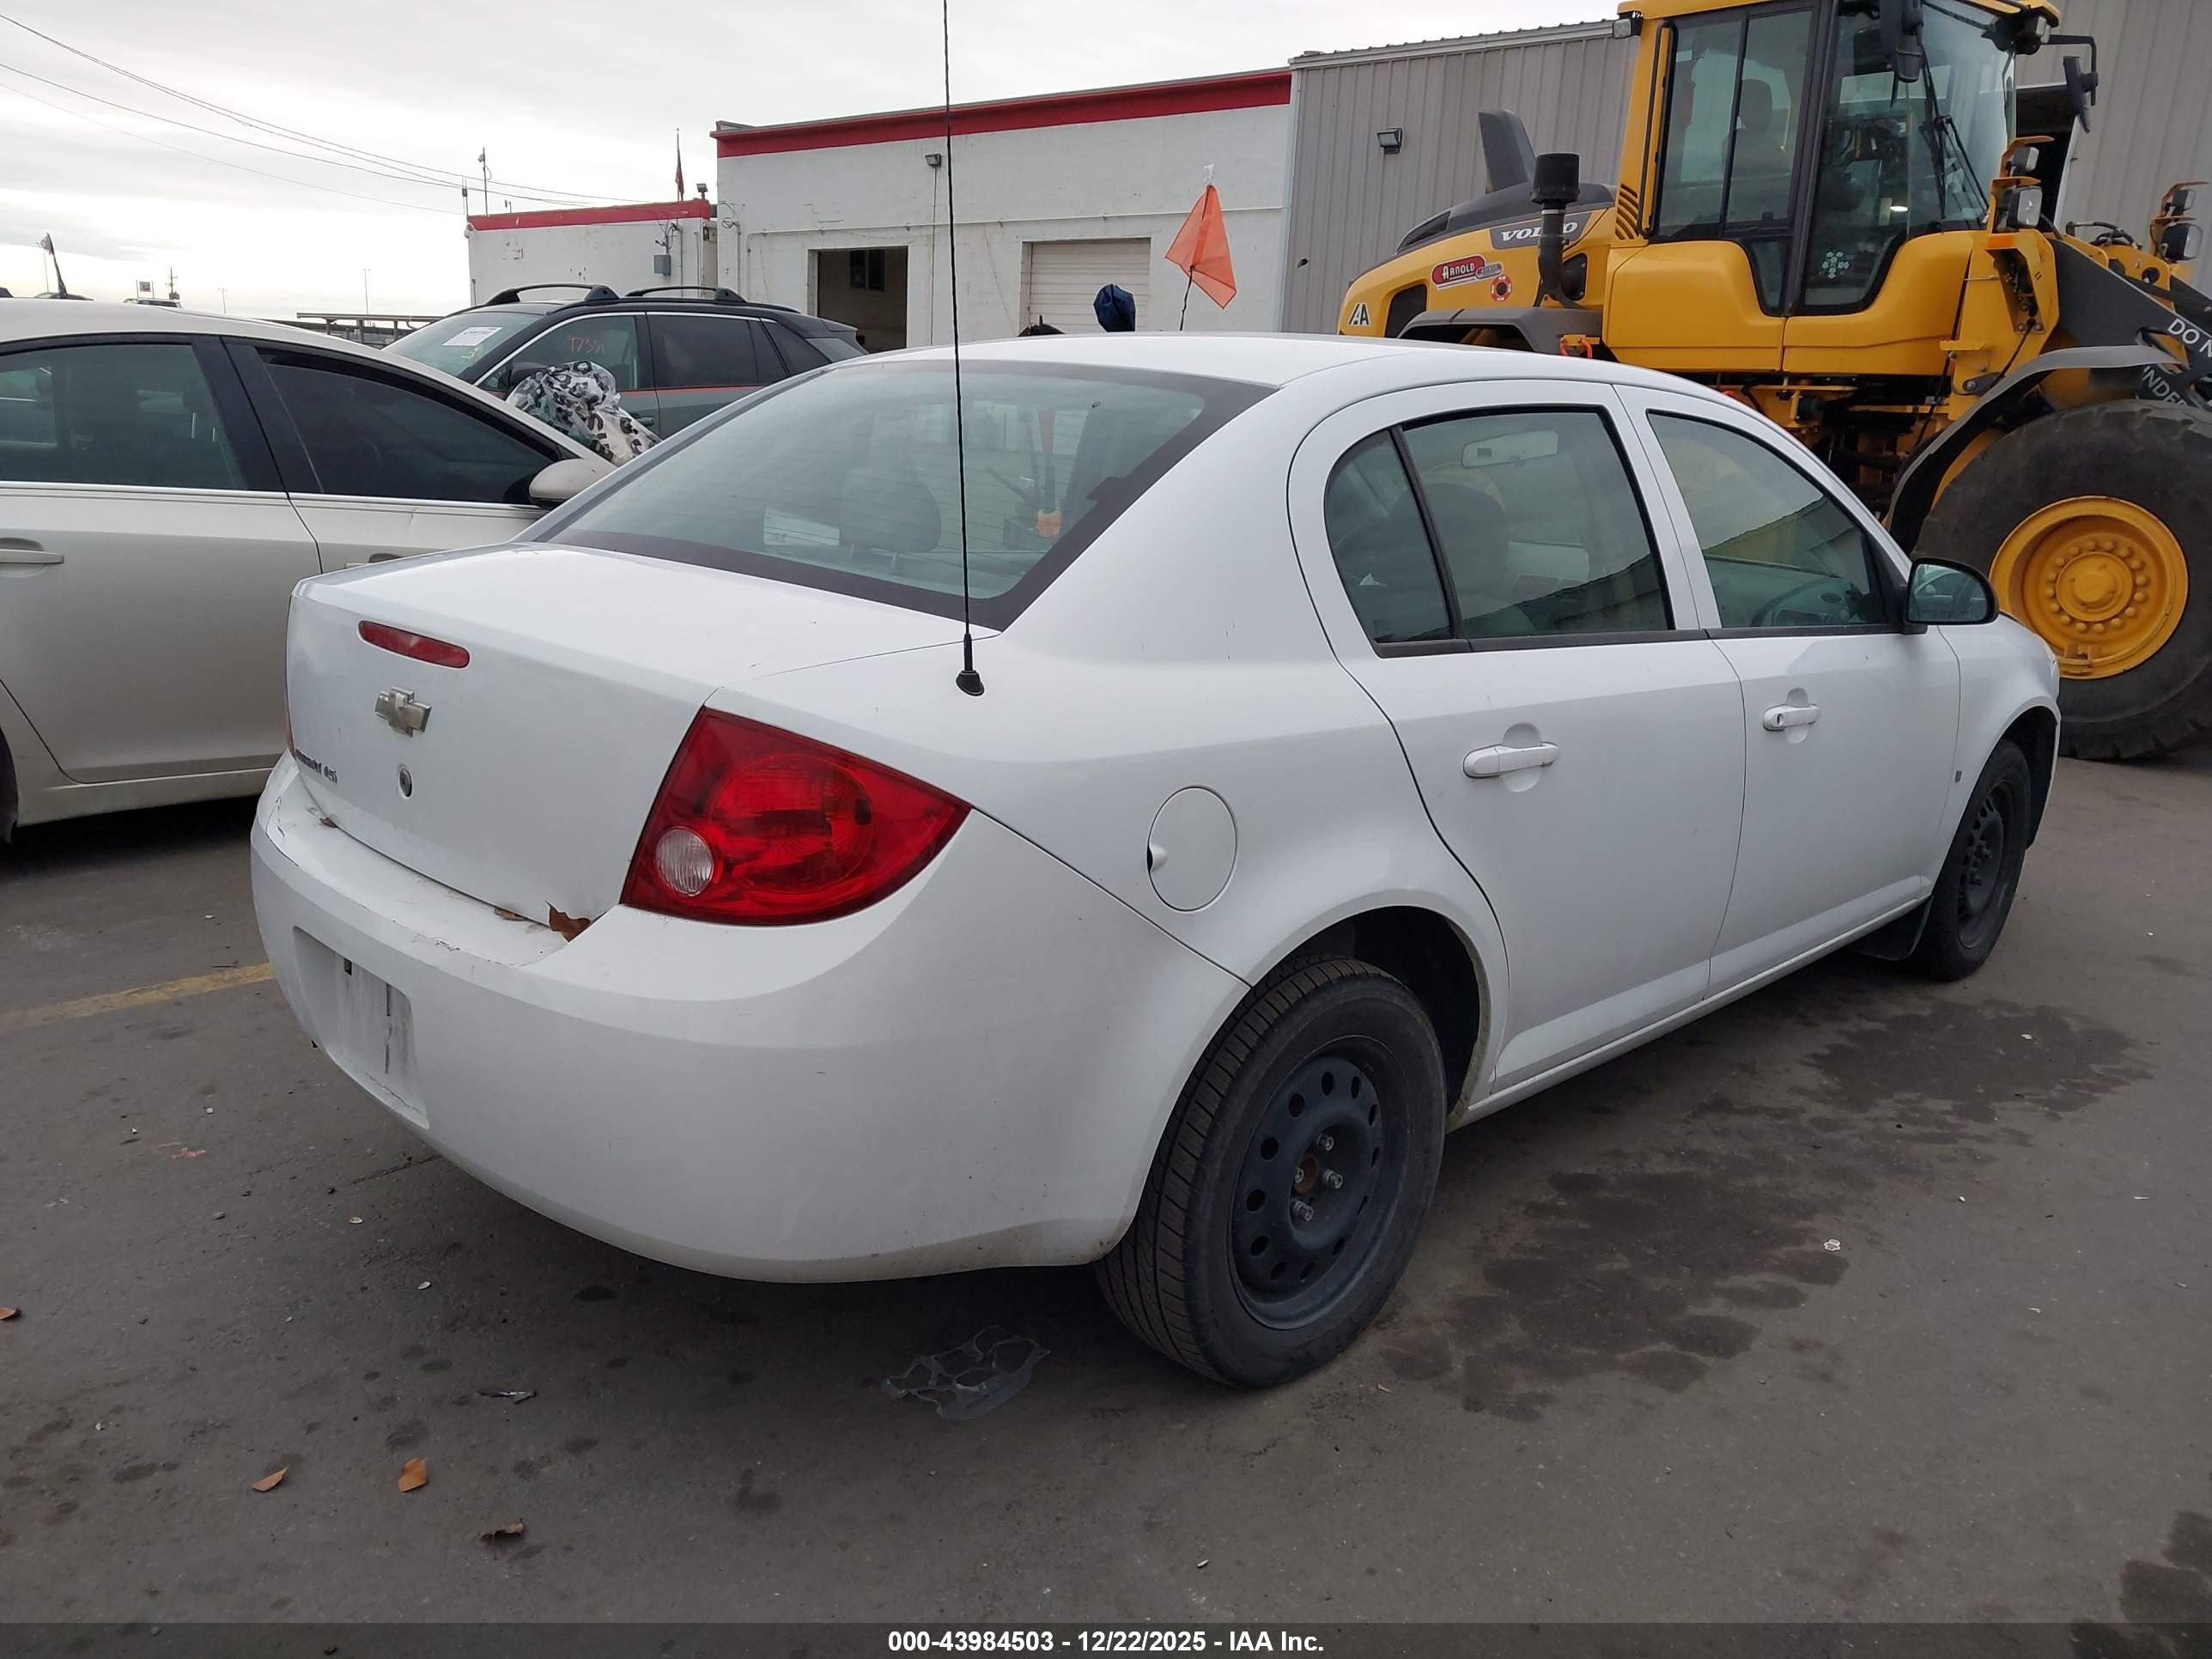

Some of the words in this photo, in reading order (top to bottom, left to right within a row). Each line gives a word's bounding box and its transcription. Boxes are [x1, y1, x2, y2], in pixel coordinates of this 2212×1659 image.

[1501, 222, 1578, 241] VOLO
[1443, 262, 1475, 280] ARNOLD
[2168, 318, 2200, 344] DO
